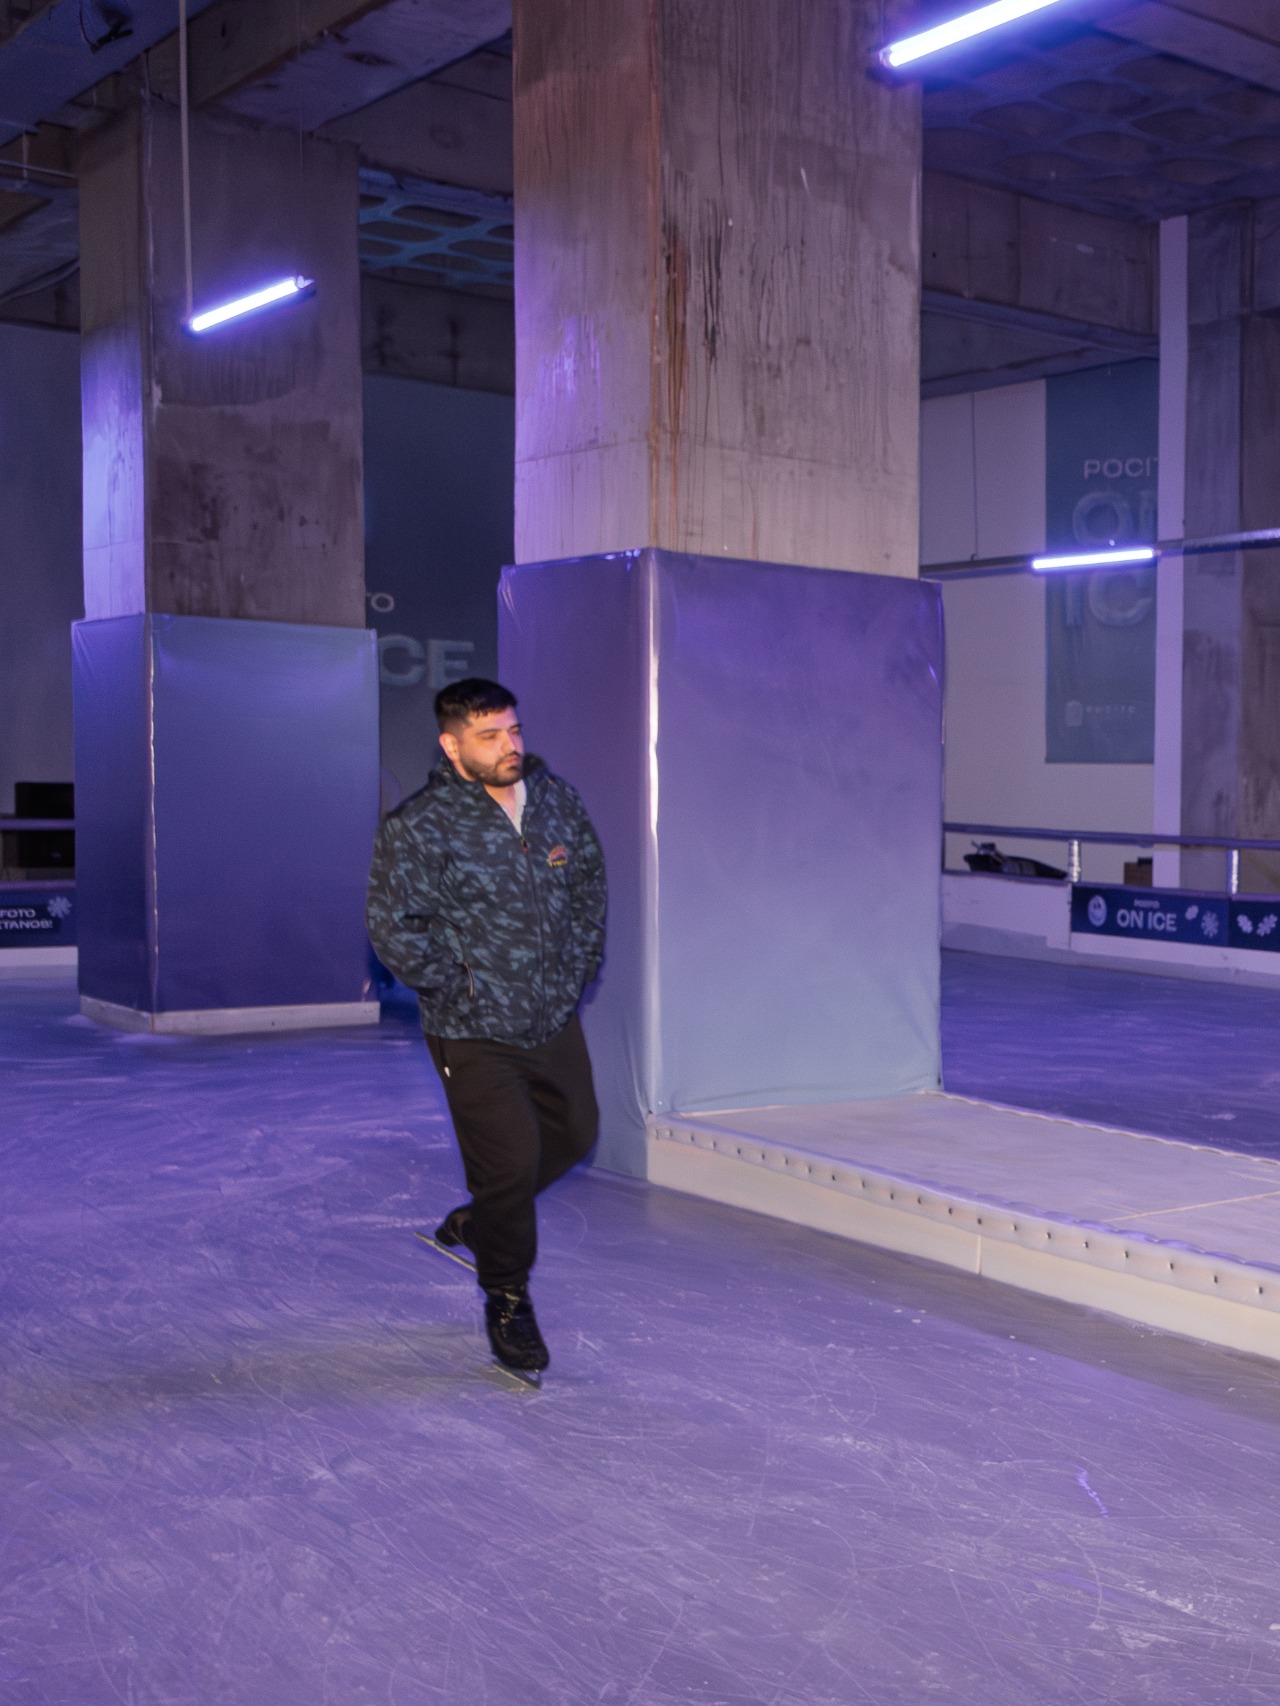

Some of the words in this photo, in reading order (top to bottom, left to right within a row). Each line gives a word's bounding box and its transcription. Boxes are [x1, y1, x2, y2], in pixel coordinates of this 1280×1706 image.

[1083, 457, 1158, 479] POCI
[378, 634, 476, 689] CE
[0, 908, 36, 918] FOTO
[1116, 908, 1144, 929] ON
[1147, 911, 1177, 932] ICE
